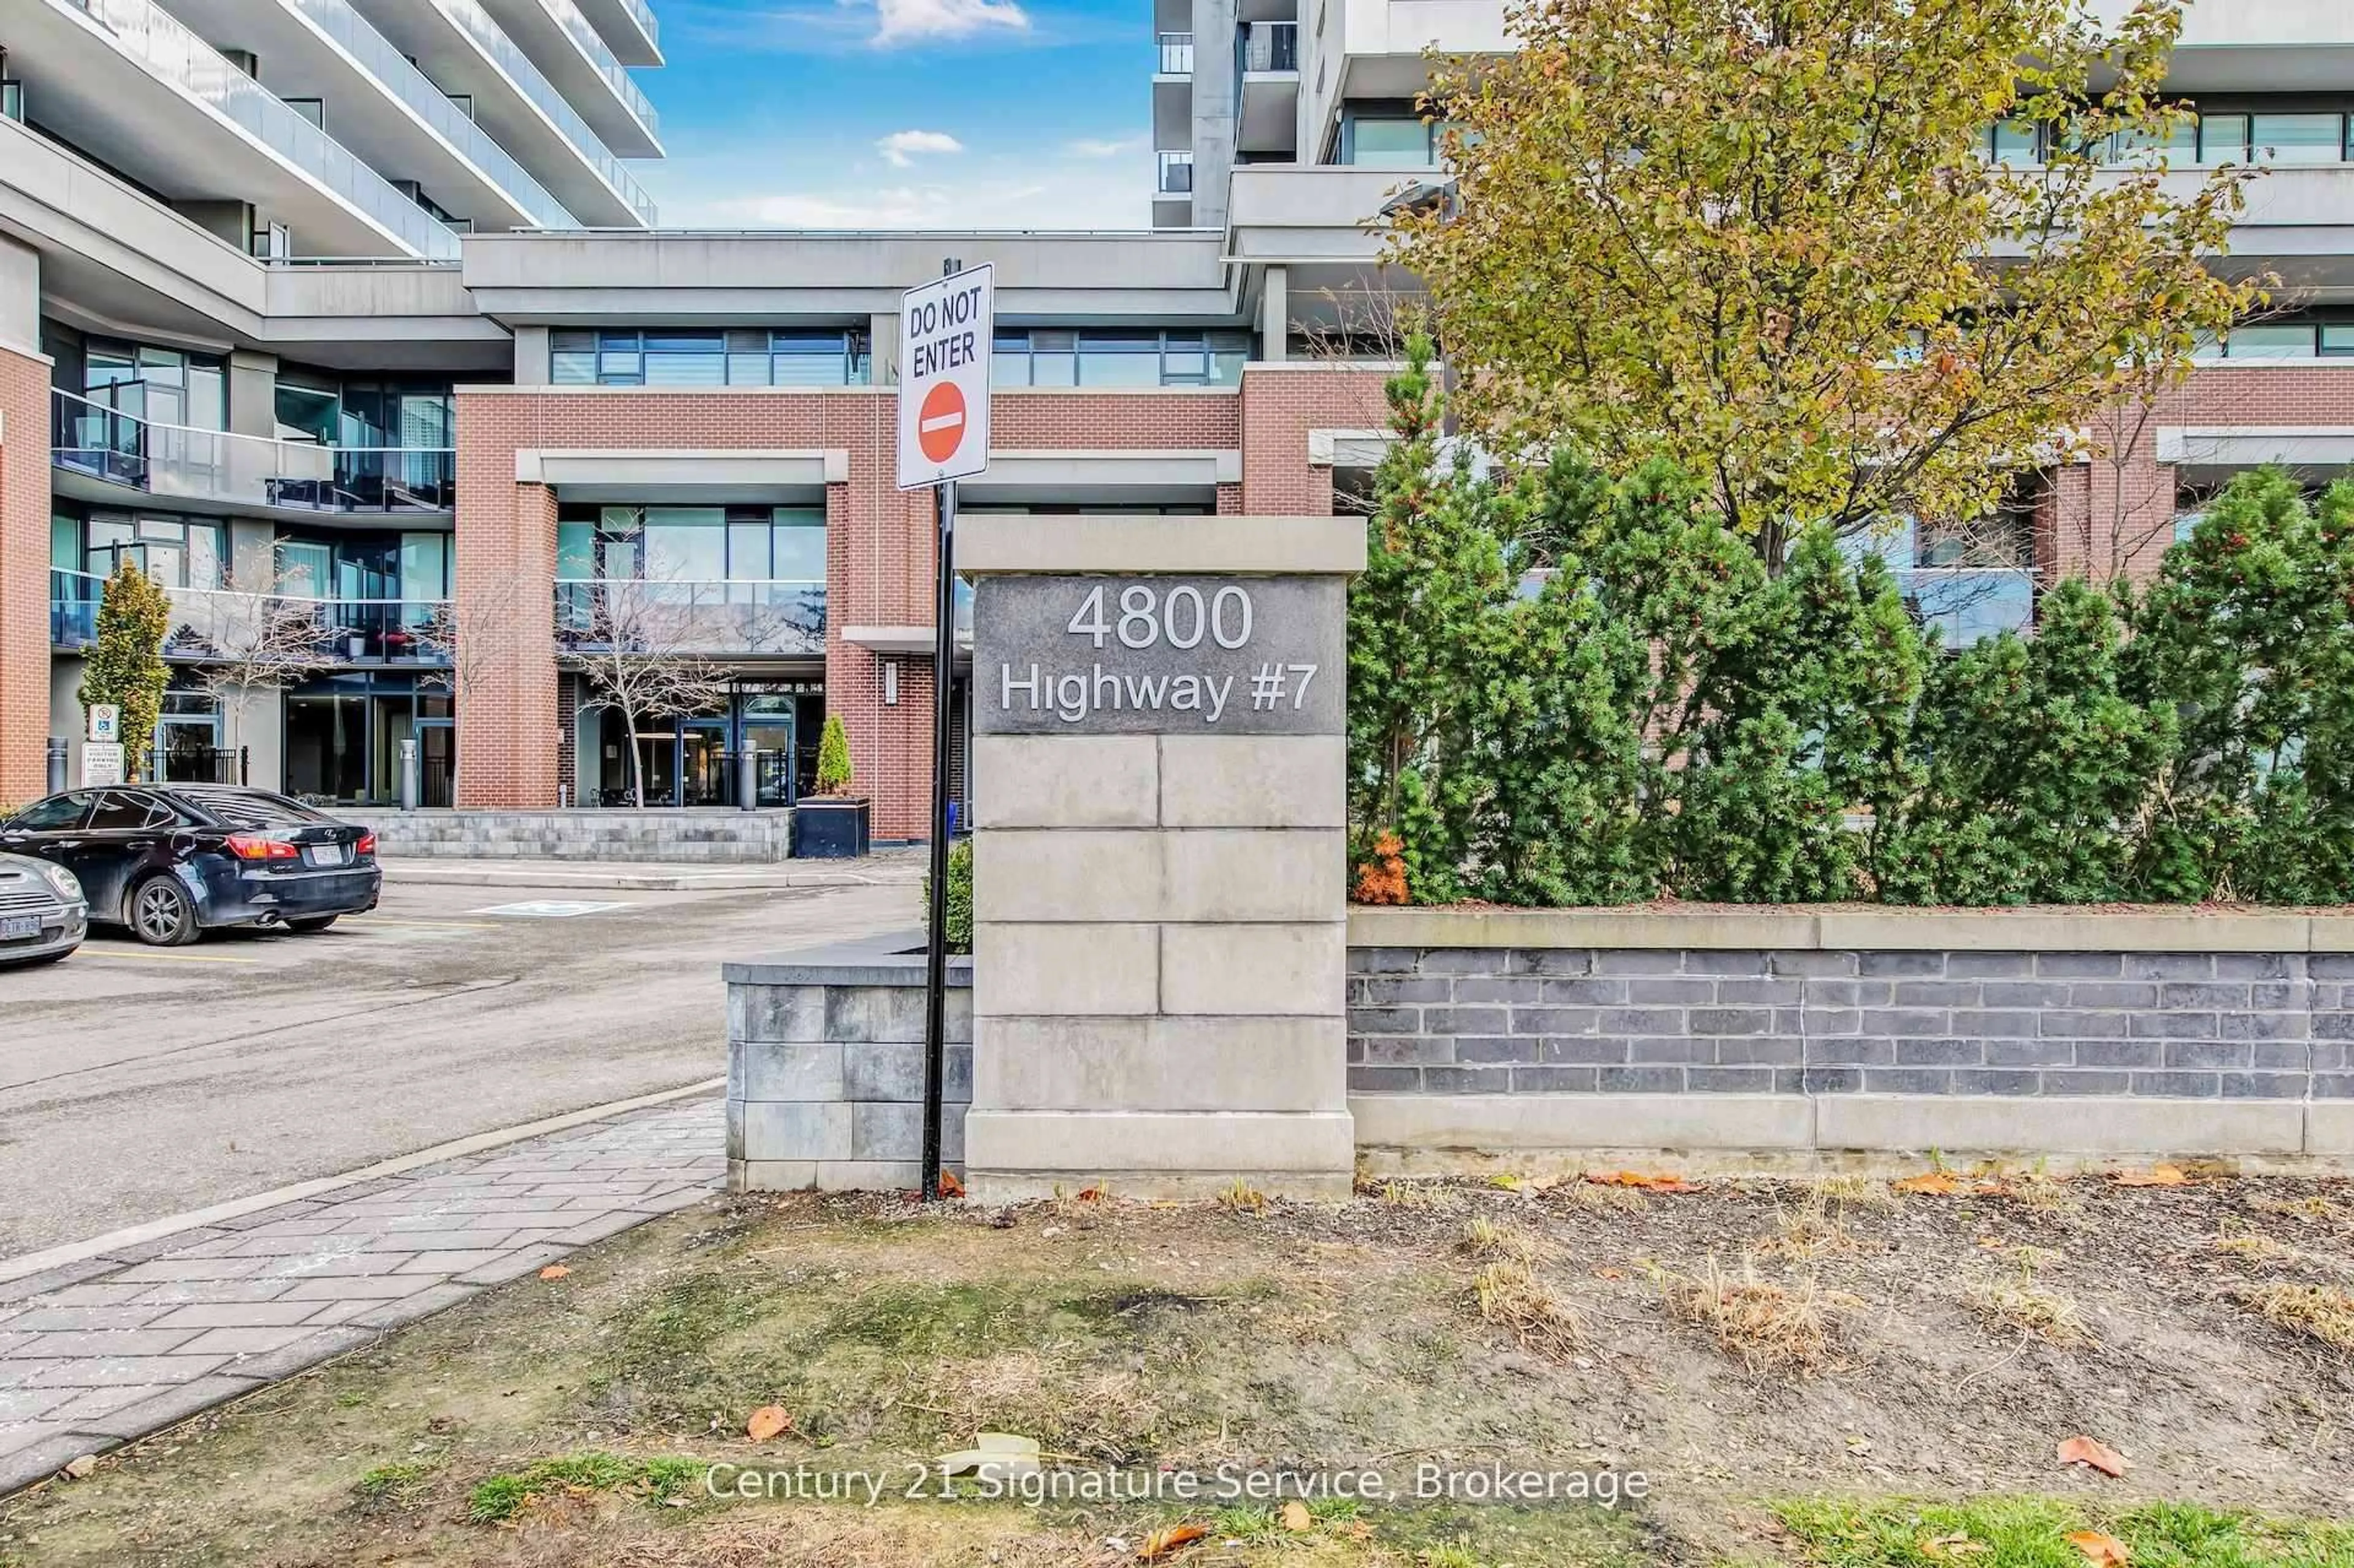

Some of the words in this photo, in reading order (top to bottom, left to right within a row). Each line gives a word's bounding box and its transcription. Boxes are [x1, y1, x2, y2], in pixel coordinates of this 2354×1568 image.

[911, 302, 936, 339] DO
[943, 286, 981, 329] NOT
[914, 332, 975, 378] ENTER
[1068, 585, 1253, 649] 4800
[1001, 663, 1234, 722] Highway
[1251, 663, 1318, 710] #7
